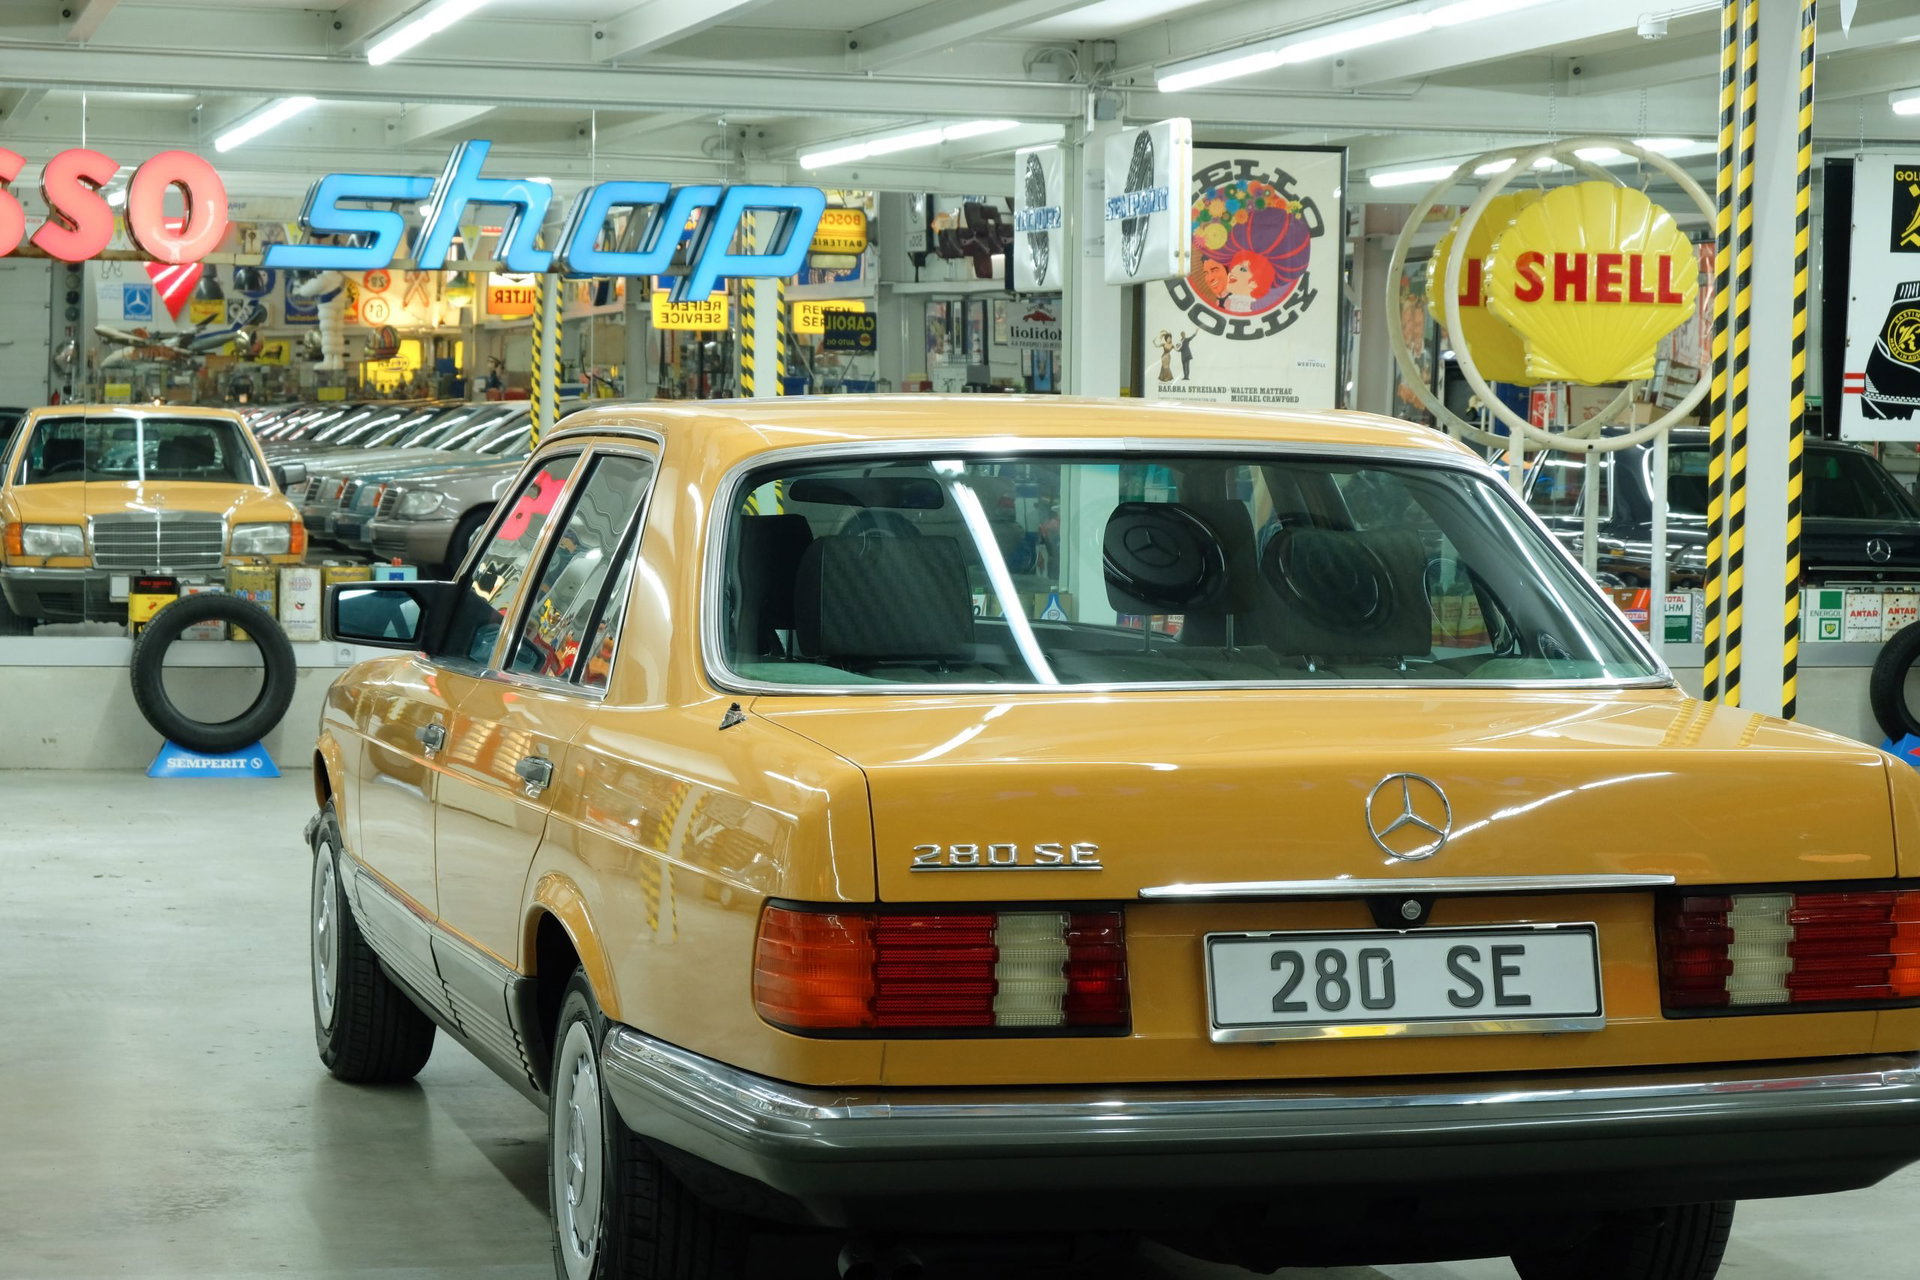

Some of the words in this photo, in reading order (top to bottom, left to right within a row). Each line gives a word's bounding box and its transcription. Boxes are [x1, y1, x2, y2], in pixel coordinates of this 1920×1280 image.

[1896, 171, 1920, 181] GOL
[1105, 186, 1168, 222] SEMPERIT
[1190, 158, 1325, 239] ELLO
[0, 147, 228, 264] SO
[264, 140, 826, 304] shop
[1514, 250, 1684, 304] SHELL
[1164, 271, 1319, 341] DOLLY
[1158, 385, 1186, 393] BARBRA
[1188, 386, 1227, 394] STREISAND
[1260, 387, 1292, 395] MATTHAU
[1231, 395, 1261, 403] MICHAEL
[1263, 395, 1299, 403] CRAWFORD
[235, 589, 272, 601] Mobil
[167, 757, 246, 769] SEMPERIT
[912, 842, 1018, 865] 280
[1034, 842, 1101, 865] SE
[1270, 947, 1396, 1014] 280
[1447, 944, 1532, 1009] SE
